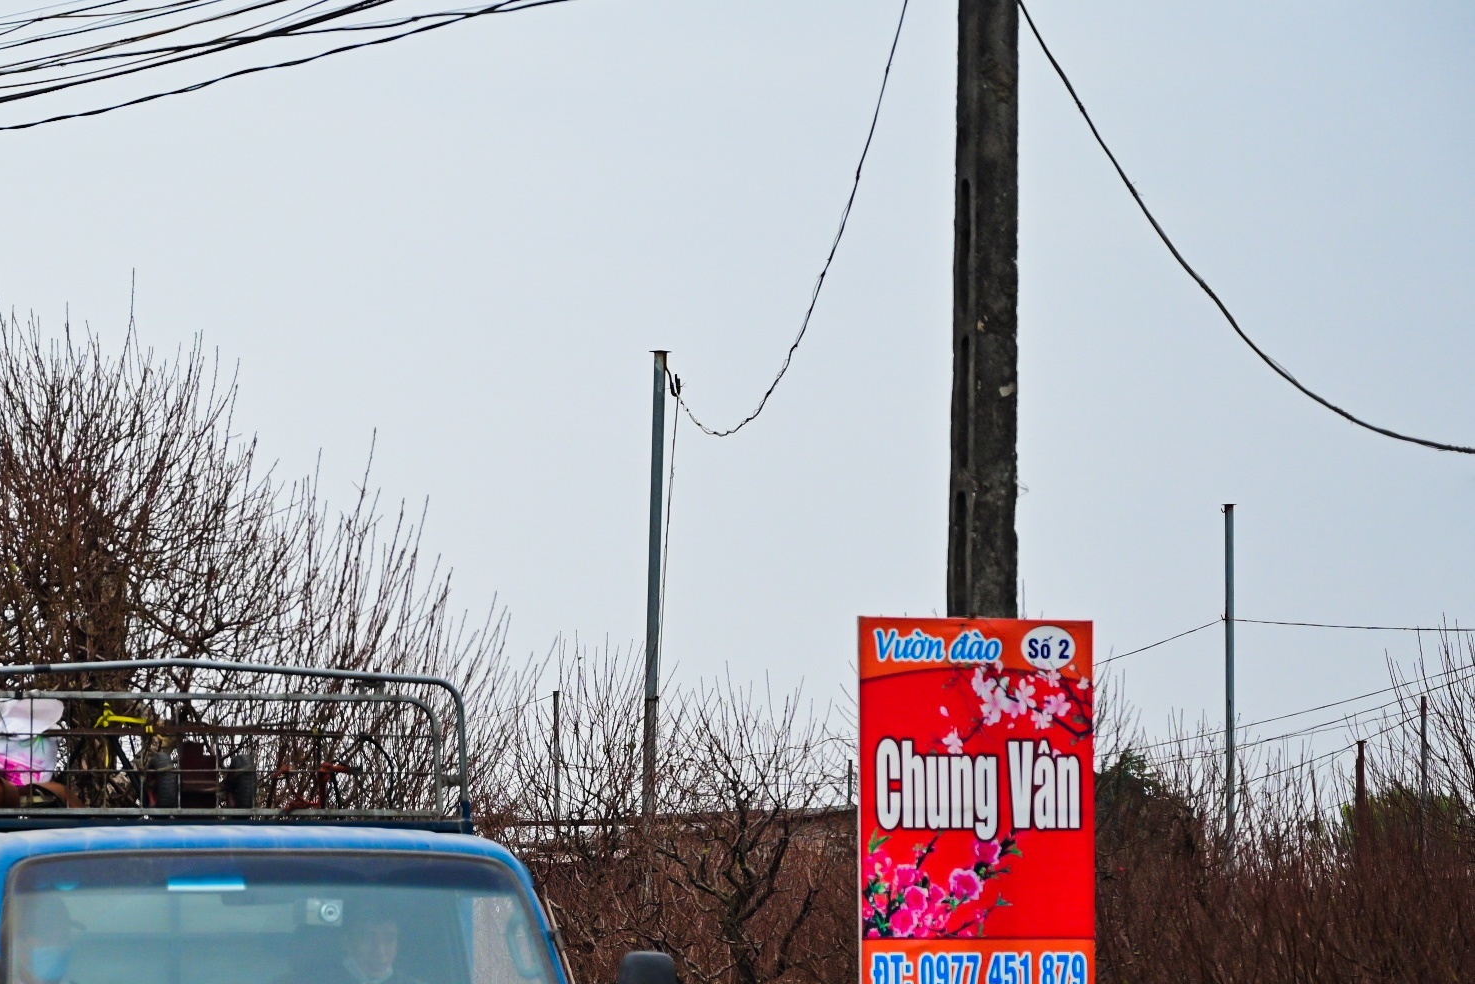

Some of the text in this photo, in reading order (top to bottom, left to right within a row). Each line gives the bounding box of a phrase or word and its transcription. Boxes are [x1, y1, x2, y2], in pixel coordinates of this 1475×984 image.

[874, 628, 1070, 663] Vườn đào Số 2
[876, 737, 1082, 841] Chung Vân
